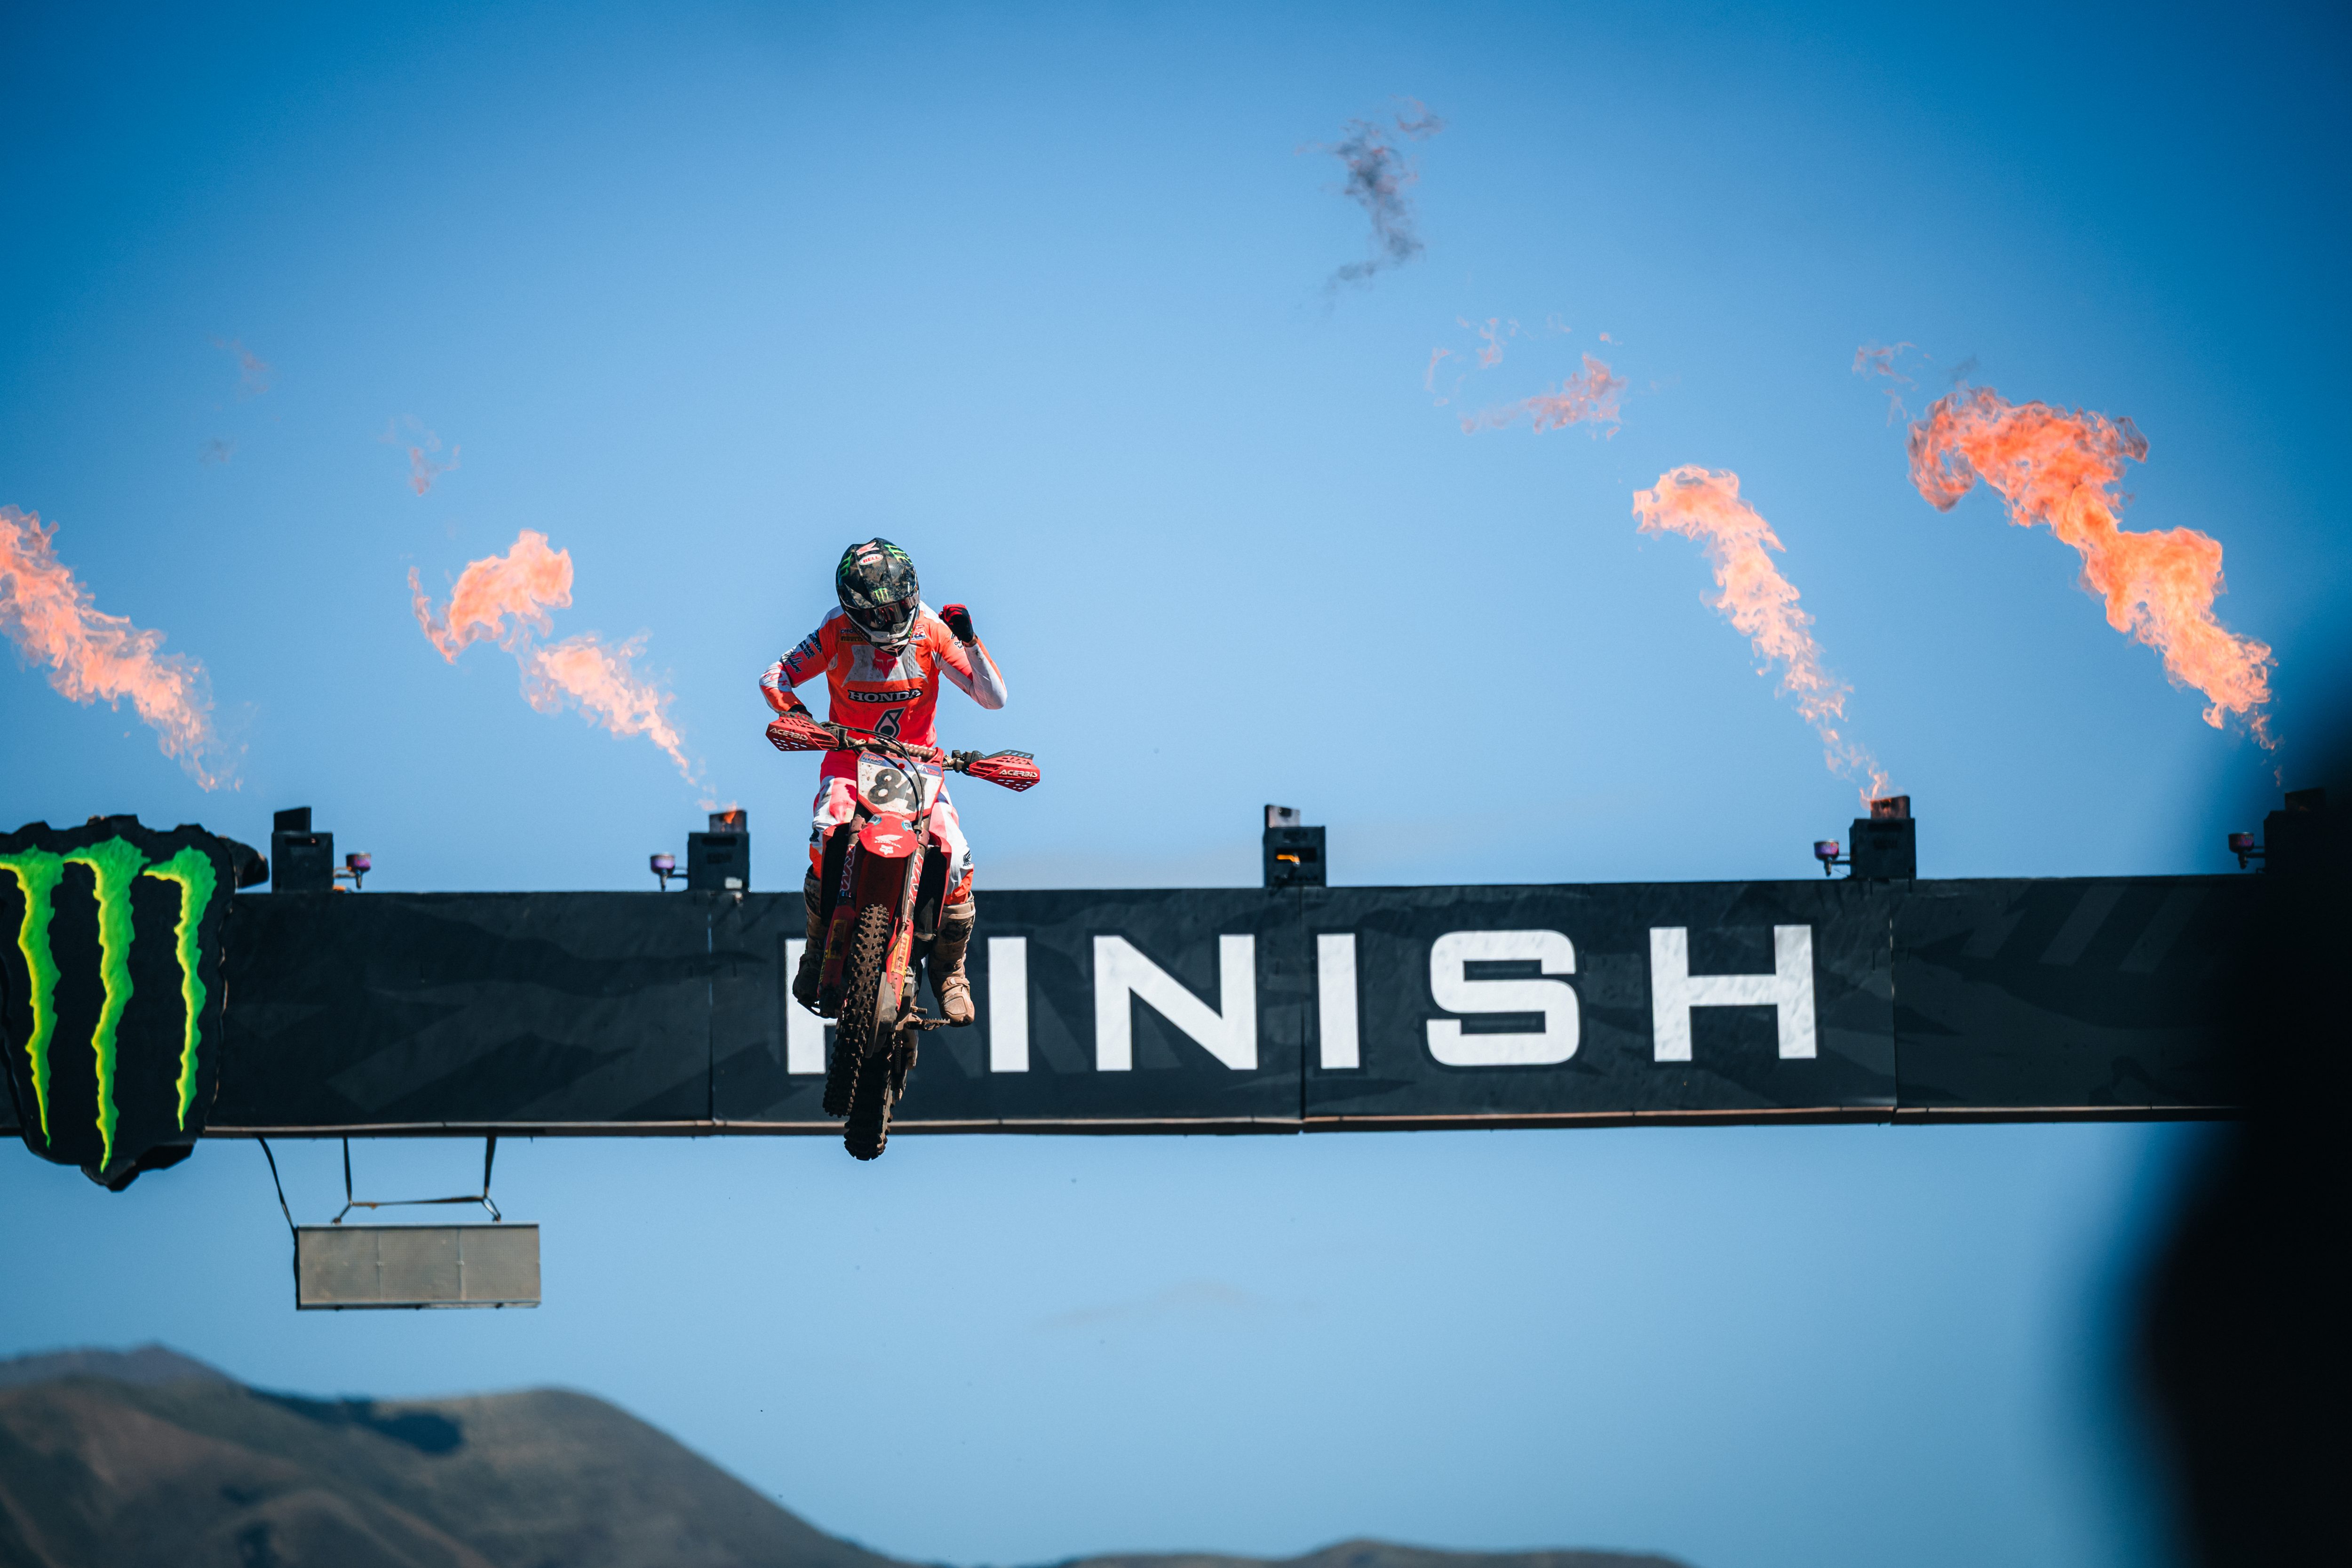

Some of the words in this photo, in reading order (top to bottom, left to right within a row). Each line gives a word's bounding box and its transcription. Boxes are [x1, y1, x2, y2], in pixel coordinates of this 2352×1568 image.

[849, 689, 922, 702] HONDA
[770, 728, 808, 741] ACERBIS
[999, 769, 1038, 778] ACERBIS
[868, 768, 928, 812] 84
[874, 840, 902, 849] HONDA
